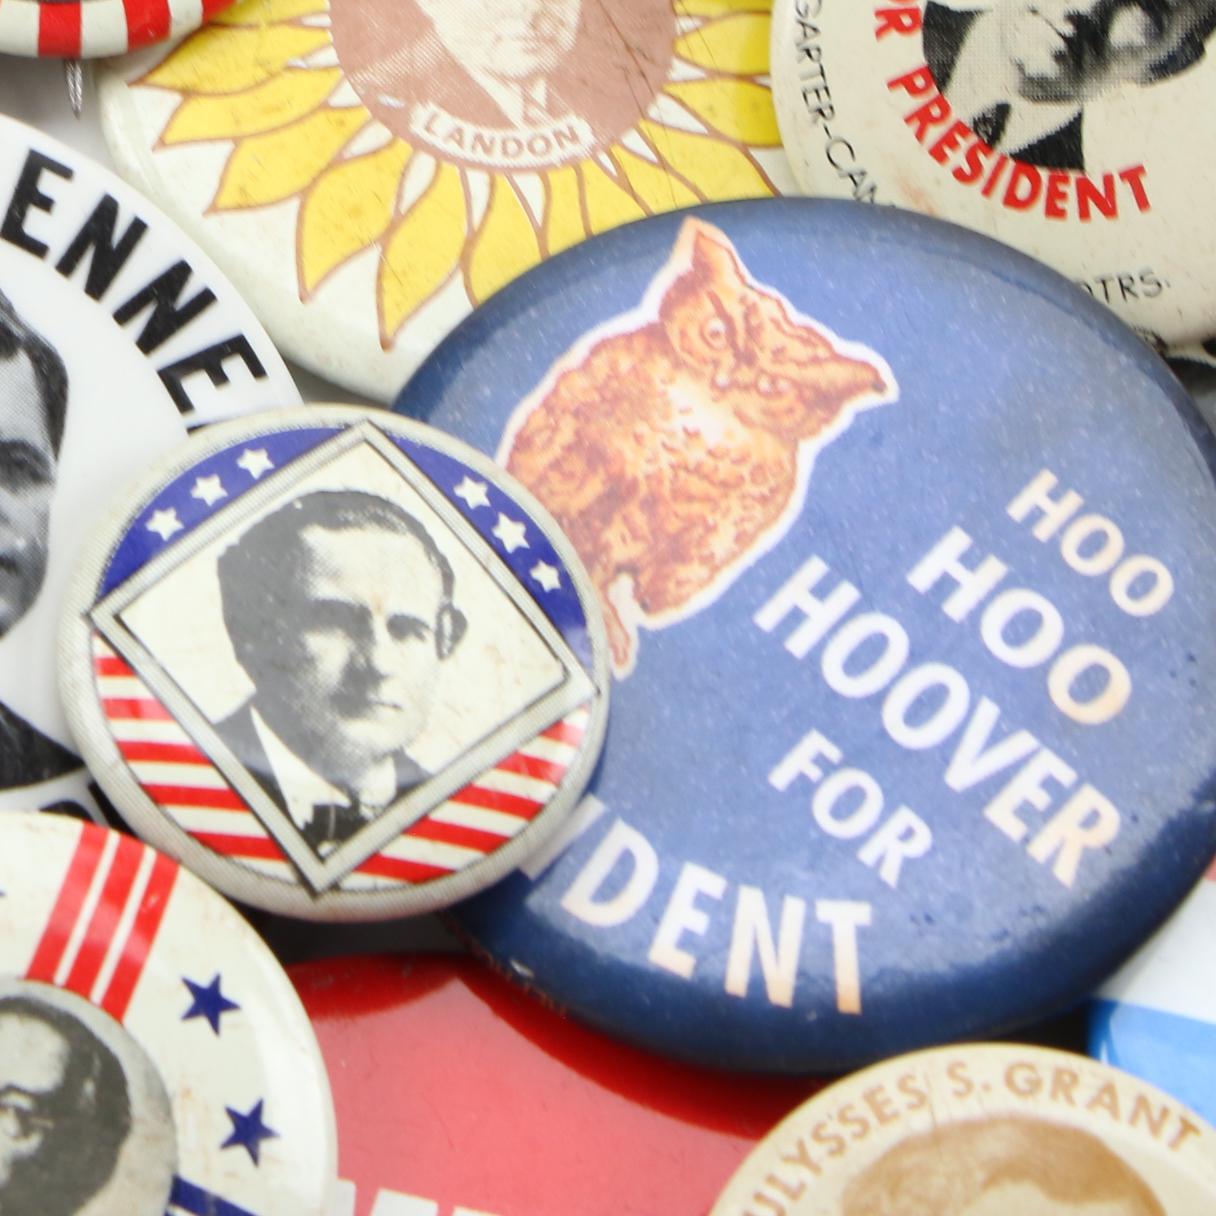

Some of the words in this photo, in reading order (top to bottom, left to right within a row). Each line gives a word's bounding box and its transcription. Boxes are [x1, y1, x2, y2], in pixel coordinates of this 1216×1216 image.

[422, 110, 582, 159] LANDON
[886, 64, 1153, 224] PRESIDENT
[1005, 468, 1176, 618] HOO
[906, 525, 1133, 726] HOO
[753, 554, 1122, 889] HOOVER
[767, 728, 934, 889] FOR
[945, 1060, 992, 1098] S.
[1002, 1061, 1202, 1152] GRANT
